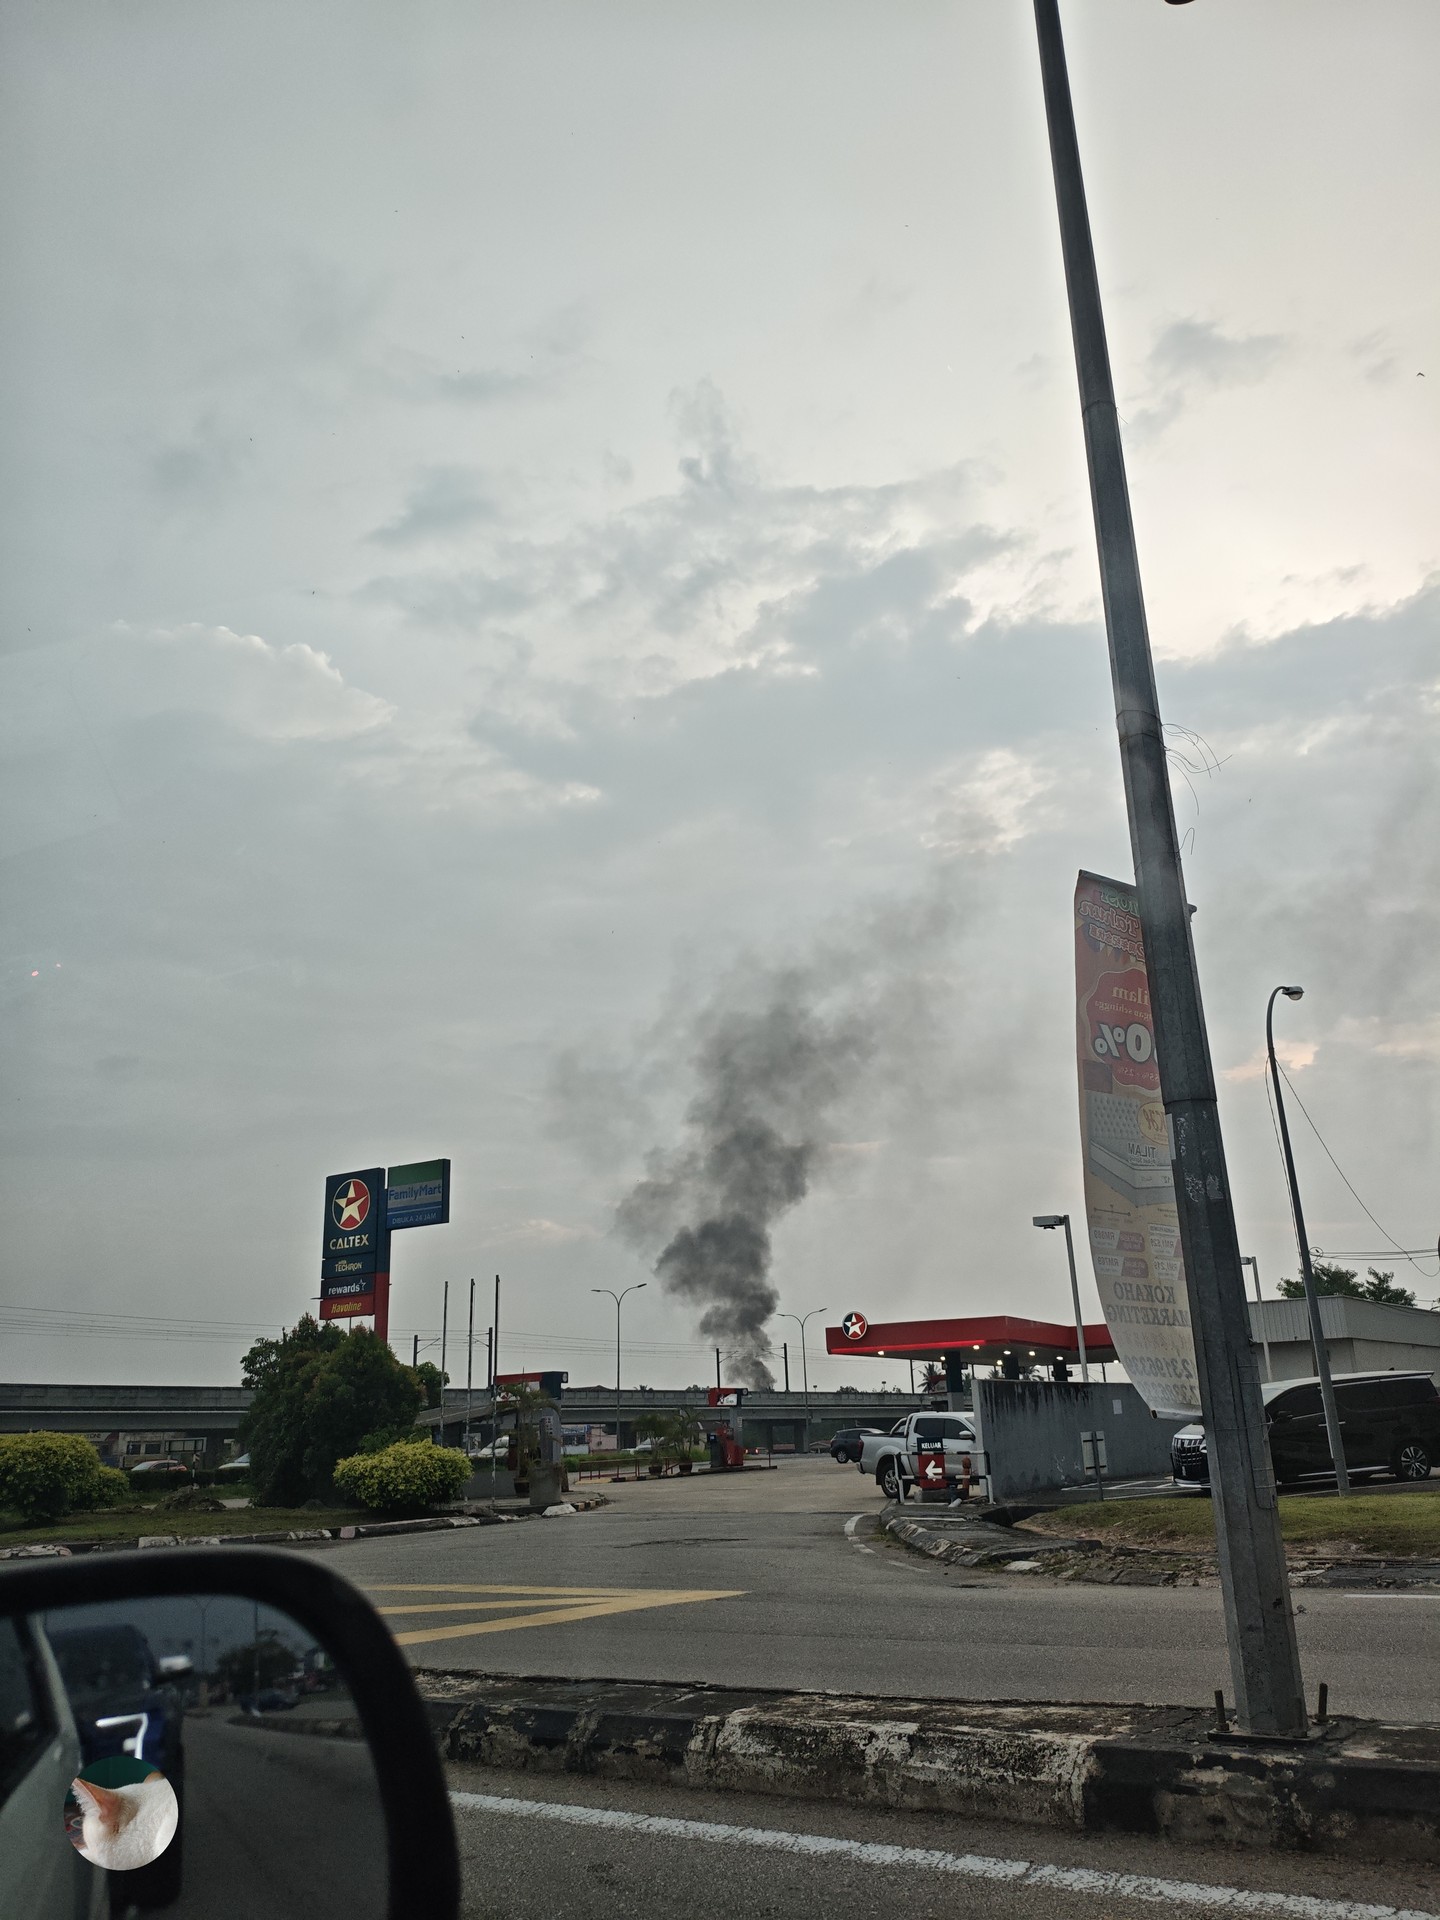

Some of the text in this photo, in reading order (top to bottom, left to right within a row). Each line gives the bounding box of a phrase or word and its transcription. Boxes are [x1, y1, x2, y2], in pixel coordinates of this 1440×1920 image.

[389, 1184, 441, 1200] FamilyMart
[423, 1212, 437, 1221] JAM
[329, 1234, 369, 1250] CALTEX
[335, 1262, 362, 1273] TECHRON
[328, 1282, 360, 1295] rewards
[331, 1302, 362, 1314] Havoline
